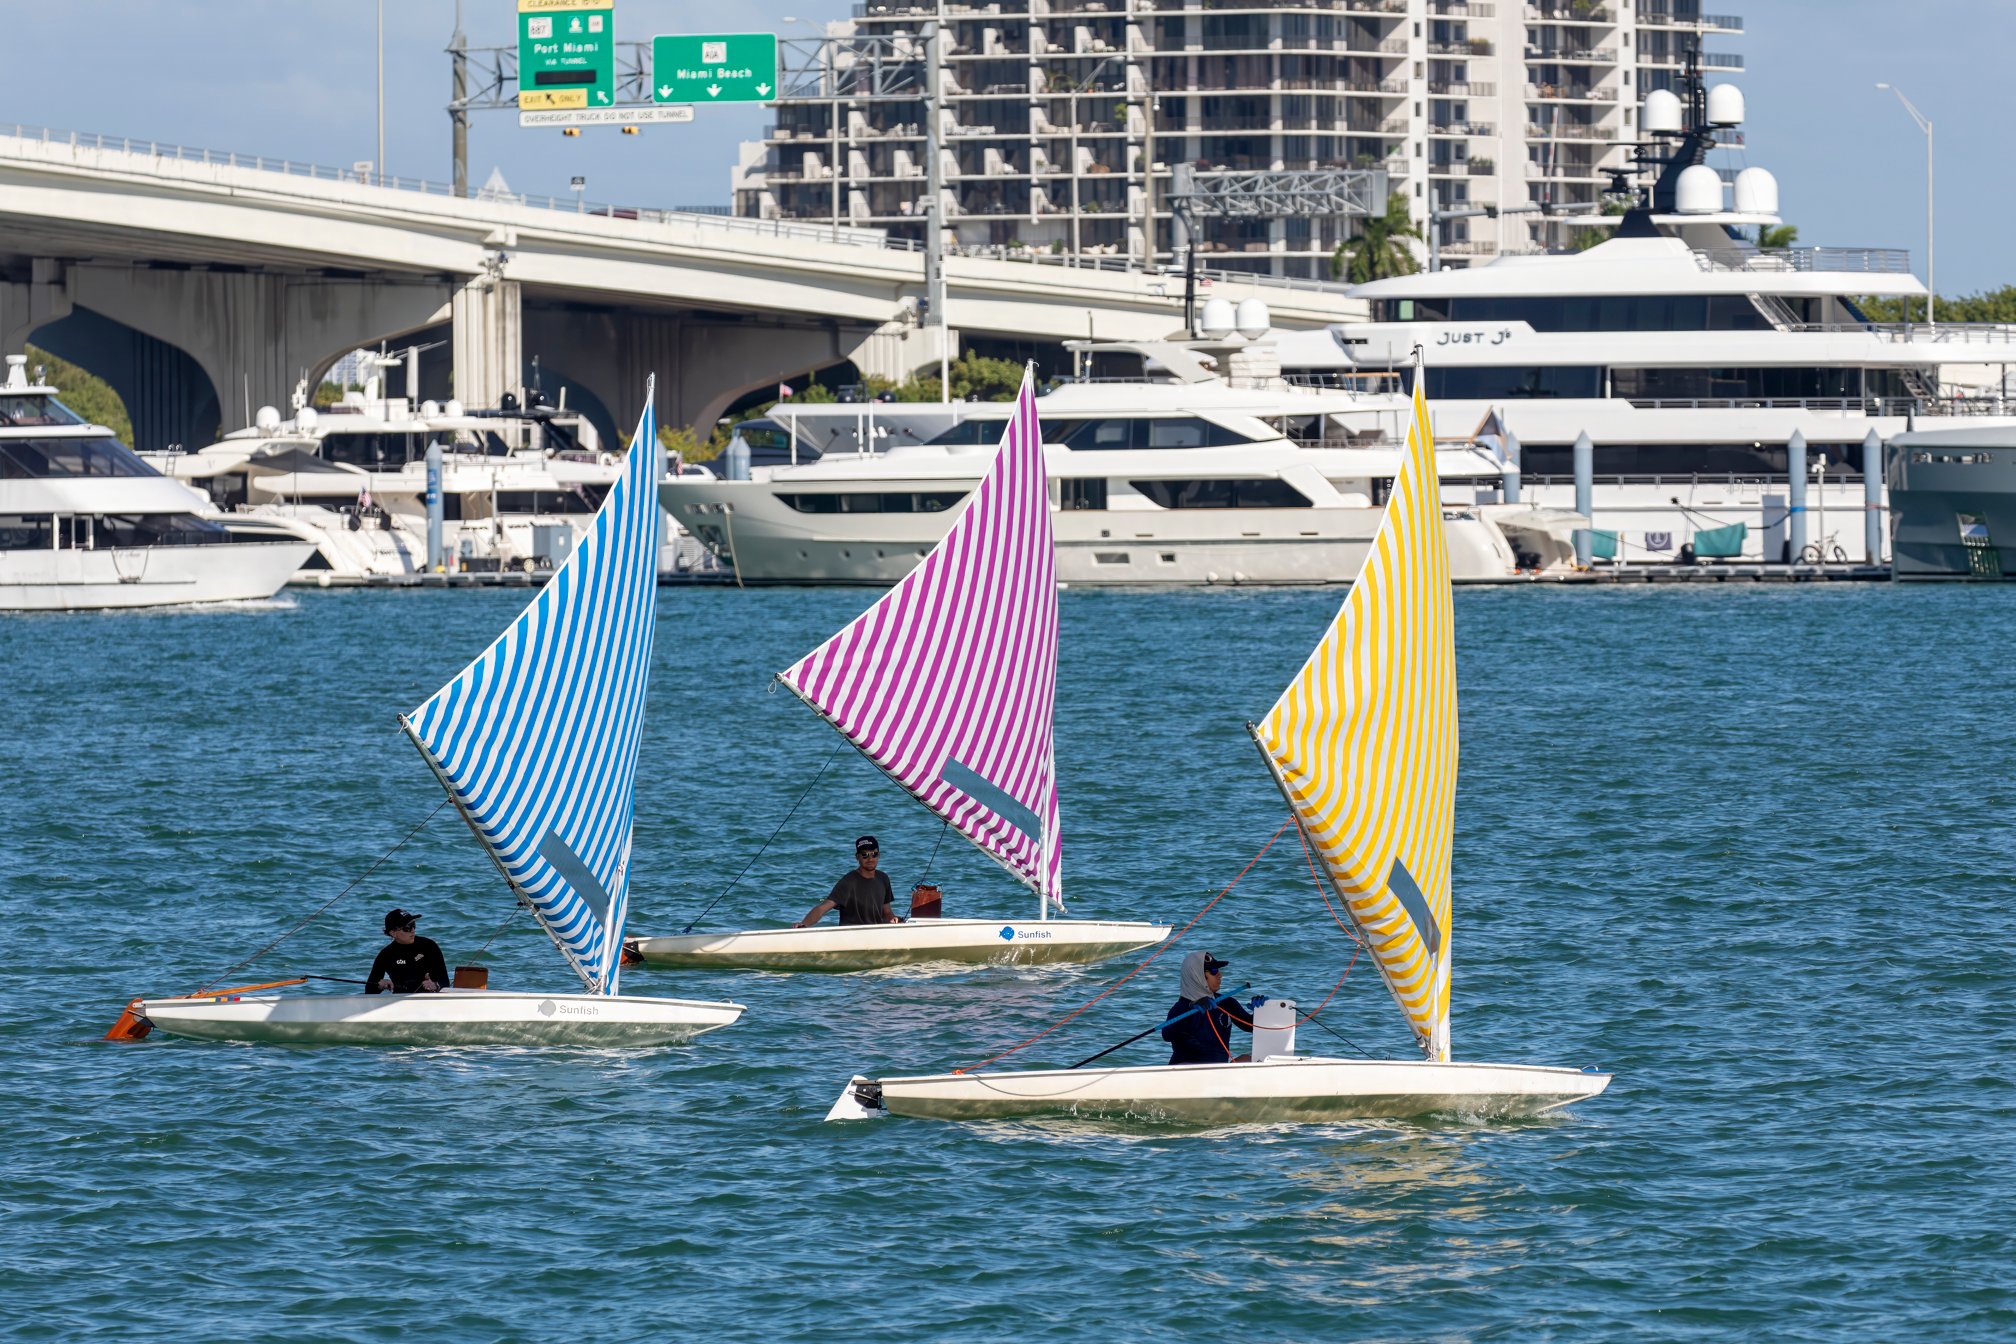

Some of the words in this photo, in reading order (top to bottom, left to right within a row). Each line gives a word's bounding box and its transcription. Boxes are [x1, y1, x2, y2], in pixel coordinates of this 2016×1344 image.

[534, 43, 558, 54] Port
[563, 42, 599, 53] Miami
[677, 69, 712, 79] Miami
[717, 67, 752, 78] Beach
[524, 95, 541, 103] EXIT
[559, 94, 581, 102] ONLY
[524, 113, 572, 122] OVERHEIGHT
[604, 111, 616, 120] DO
[619, 111, 634, 120] NOT
[638, 110, 654, 119] USE
[658, 109, 688, 118] TUNNEL
[1436, 332, 1484, 345] JUST
[1017, 930, 1052, 939] Sunfish
[559, 1004, 599, 1016] Sunfish
